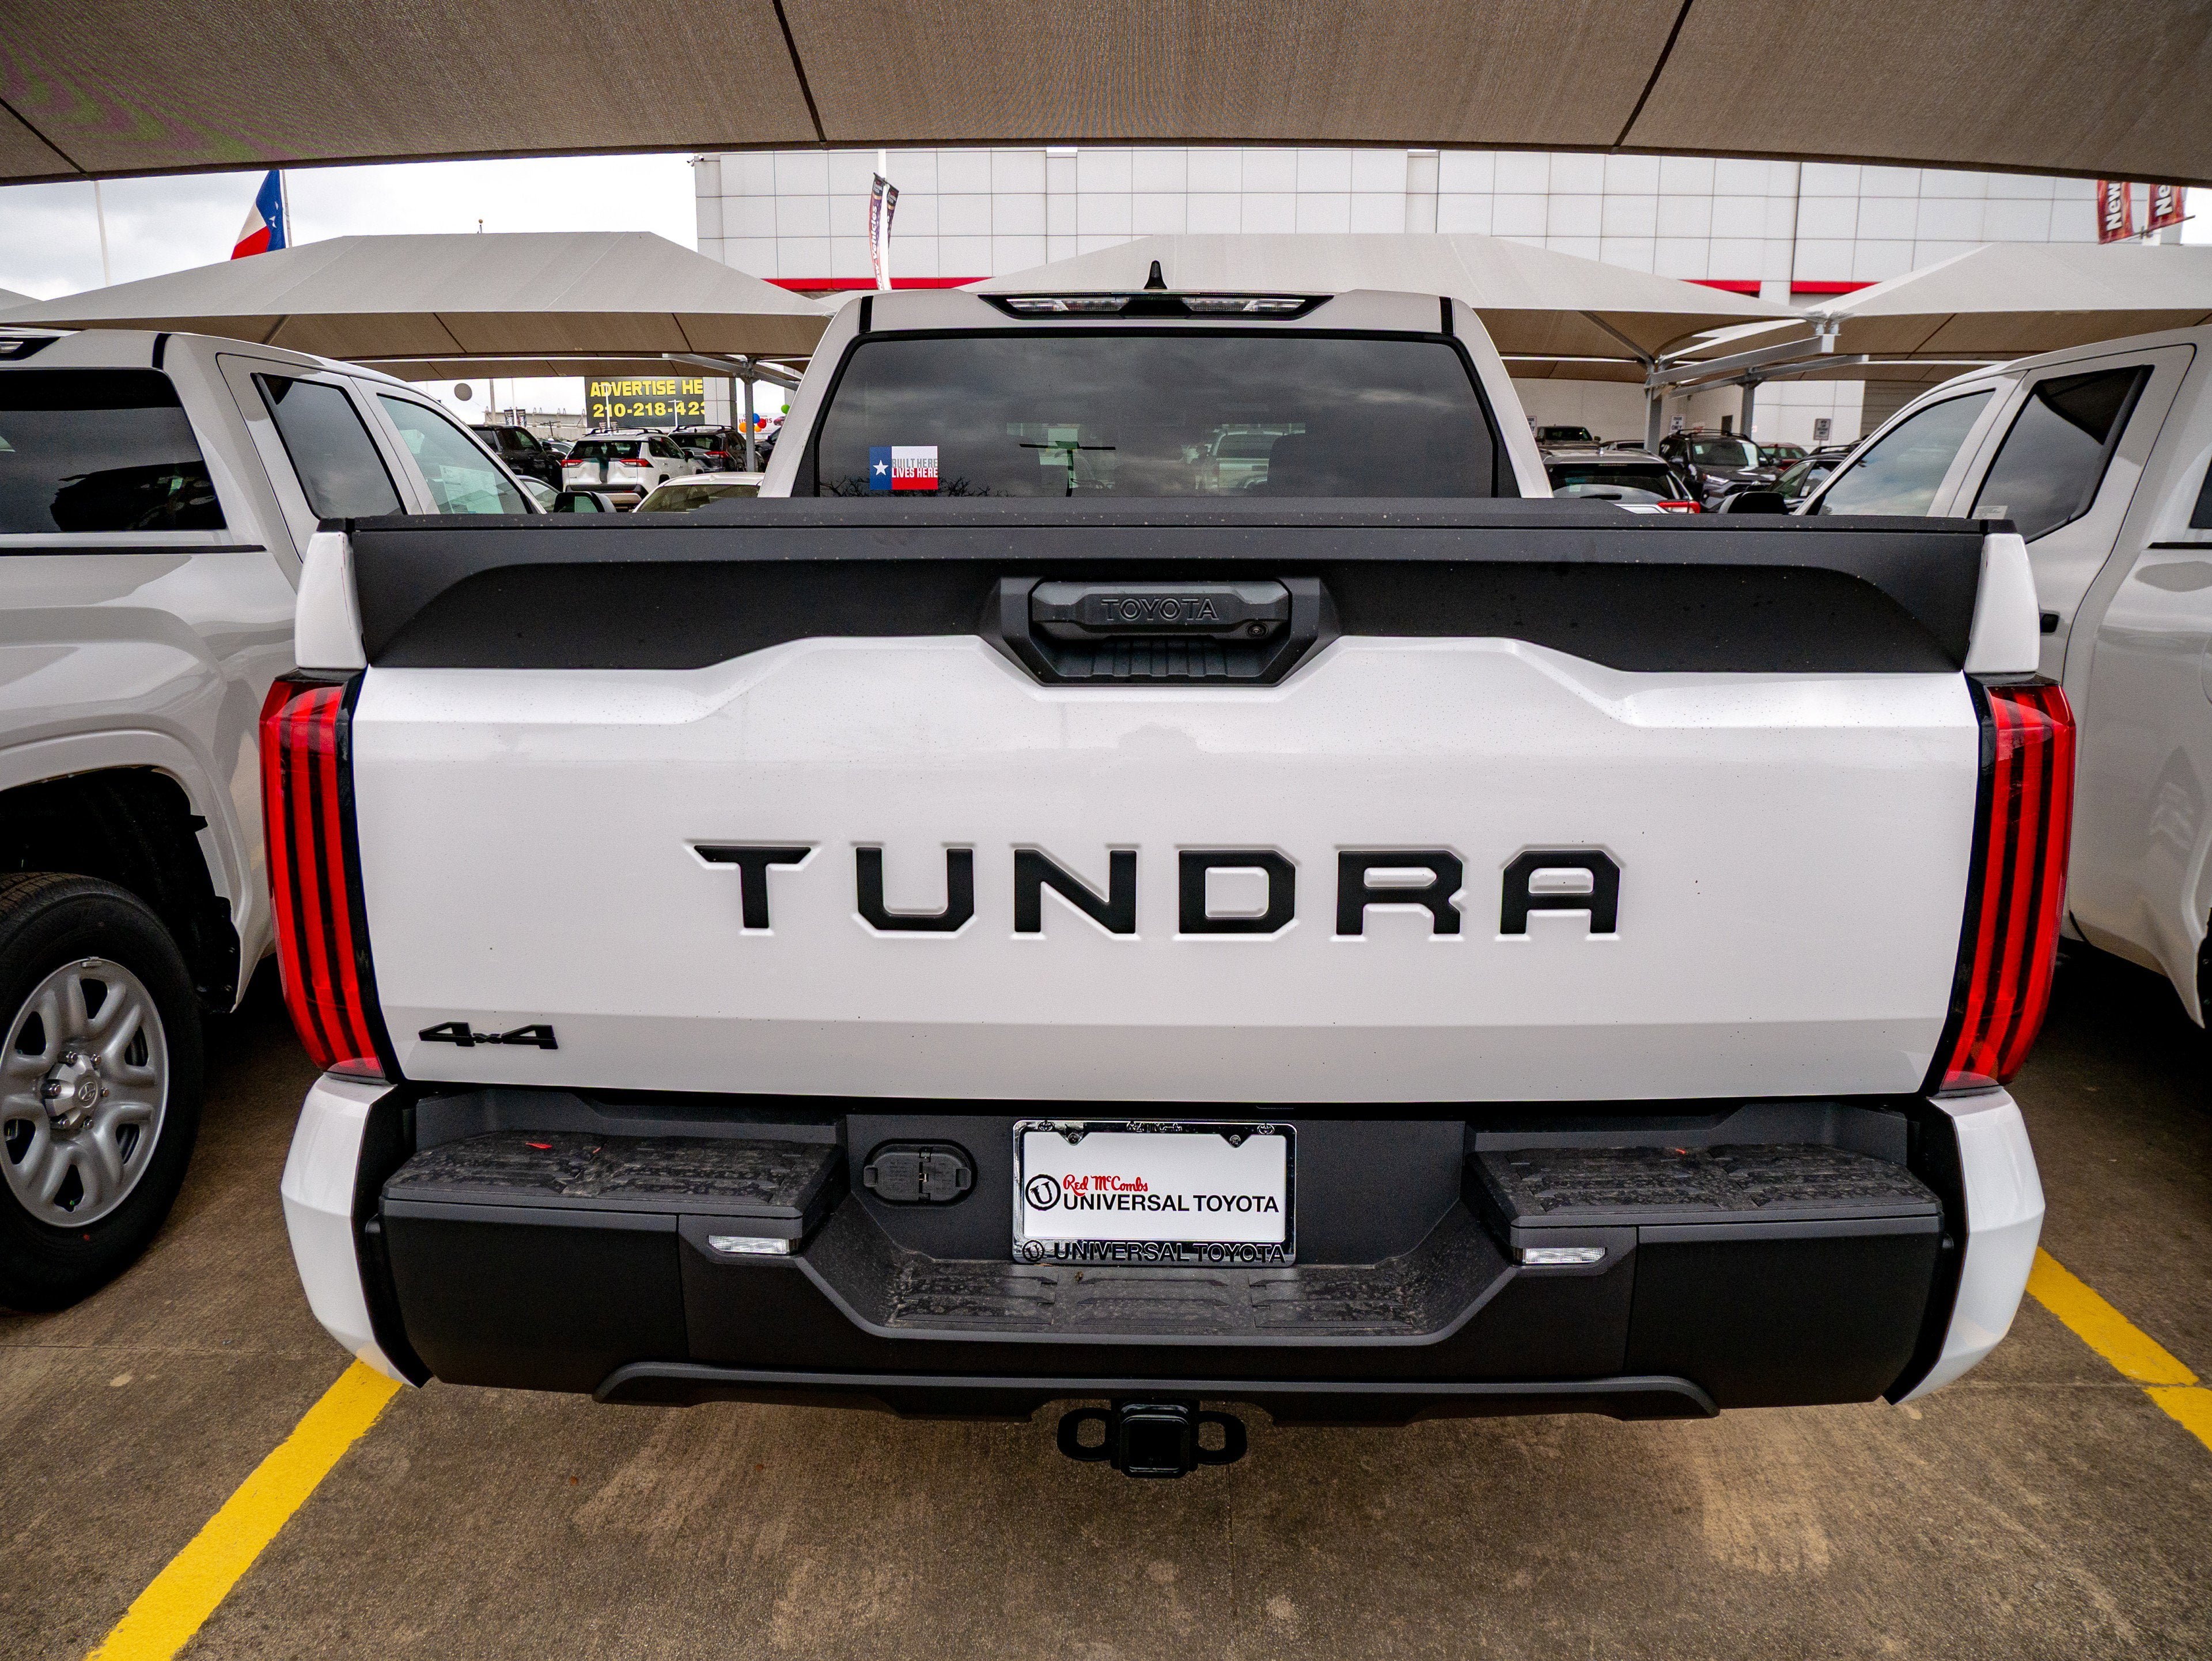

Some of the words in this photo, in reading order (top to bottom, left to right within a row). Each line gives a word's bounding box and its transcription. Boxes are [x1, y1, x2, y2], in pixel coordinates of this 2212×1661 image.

[2106, 183, 2122, 231] New
[590, 380, 676, 397] ADVERTISE
[892, 459, 915, 468] BUILT
[917, 459, 938, 468] HERE
[892, 468, 915, 478] LIVES
[917, 468, 938, 478] HERE
[1101, 597, 1219, 621] TOYOTA
[690, 844, 1622, 938] TUNDRA
[1063, 1174, 1088, 1197] Red
[1090, 1175, 1149, 1193] McCombs
[1063, 1194, 1190, 1212] UNIVERSAL
[1193, 1195, 1279, 1213] TOYOTA
[1054, 1241, 1190, 1262] UNIVERSAL
[1193, 1243, 1286, 1263] TOYOTA
